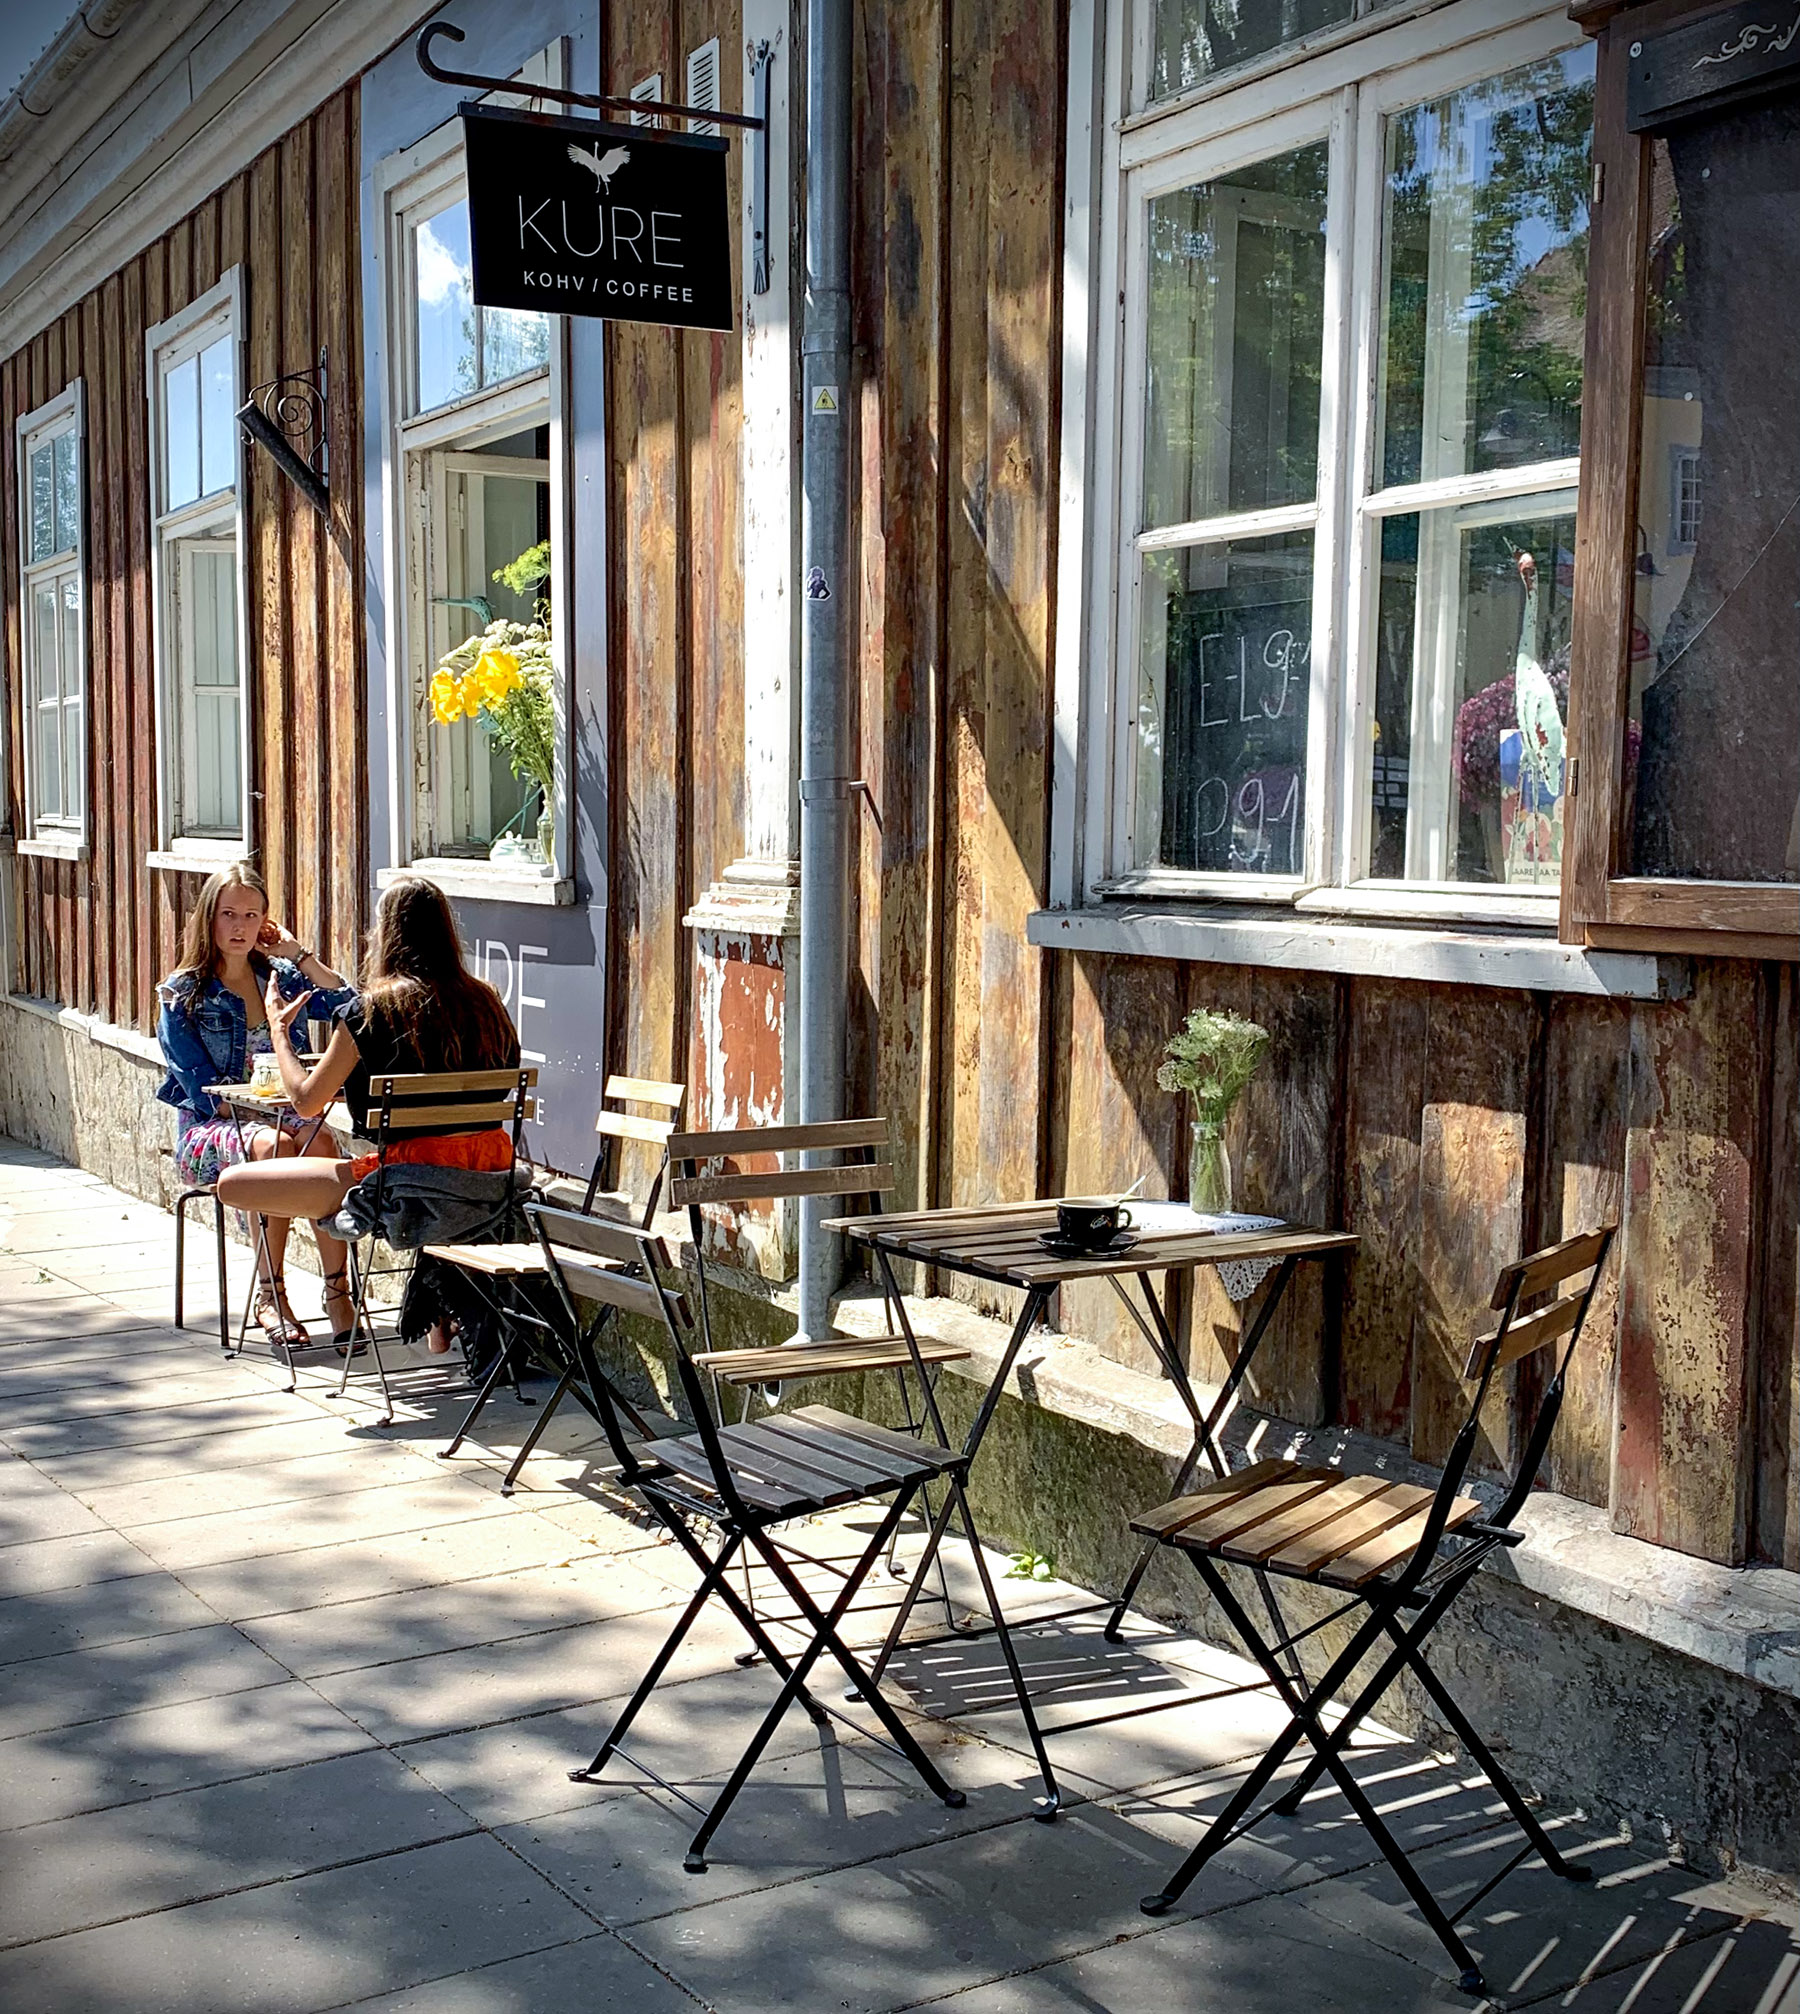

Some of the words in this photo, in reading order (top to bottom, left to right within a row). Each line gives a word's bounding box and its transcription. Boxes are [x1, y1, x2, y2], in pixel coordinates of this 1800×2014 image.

[519, 195, 684, 268] KURE
[524, 270, 584, 291] KOHV
[606, 279, 693, 303] COFFEE
